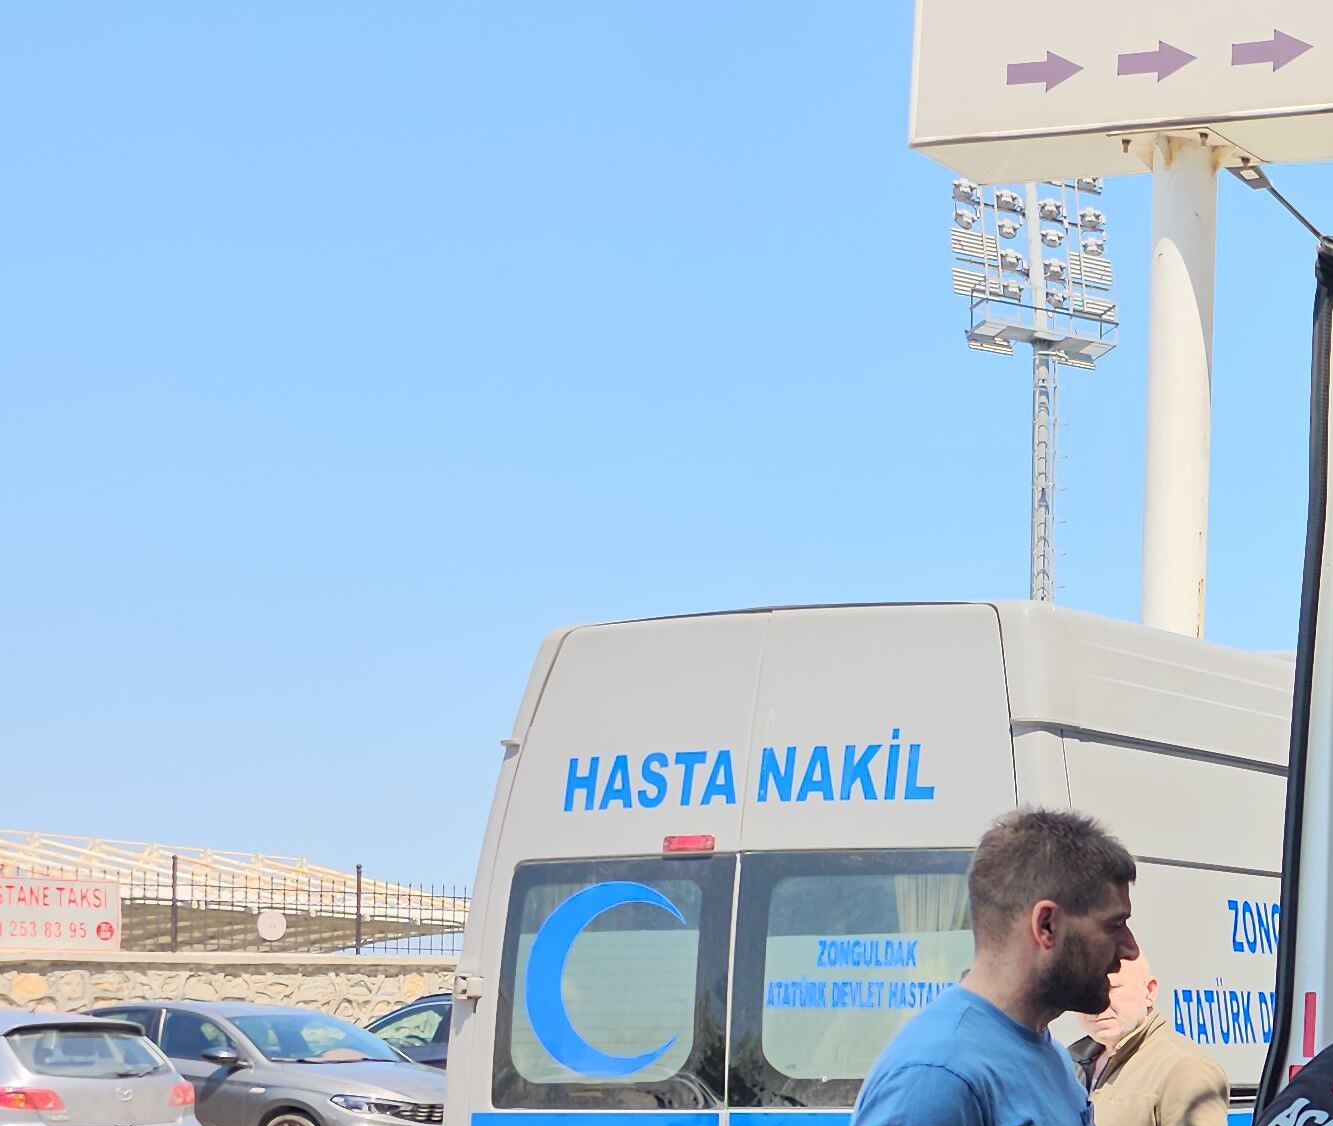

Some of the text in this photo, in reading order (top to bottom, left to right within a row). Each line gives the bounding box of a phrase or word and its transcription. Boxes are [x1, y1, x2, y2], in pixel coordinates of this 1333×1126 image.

[563, 728, 935, 812] HASTA NAKİL
[0, 885, 50, 907] TANE
[10, 920, 37, 938] 253
[44, 921, 62, 938] 83
[69, 922, 87, 939] 95
[816, 939, 918, 967] ZONGULDAK
[832, 981, 884, 1008] DEVLET
[888, 981, 956, 1009] HASTAN
[1174, 977, 1275, 1045] ATATÜRK D
